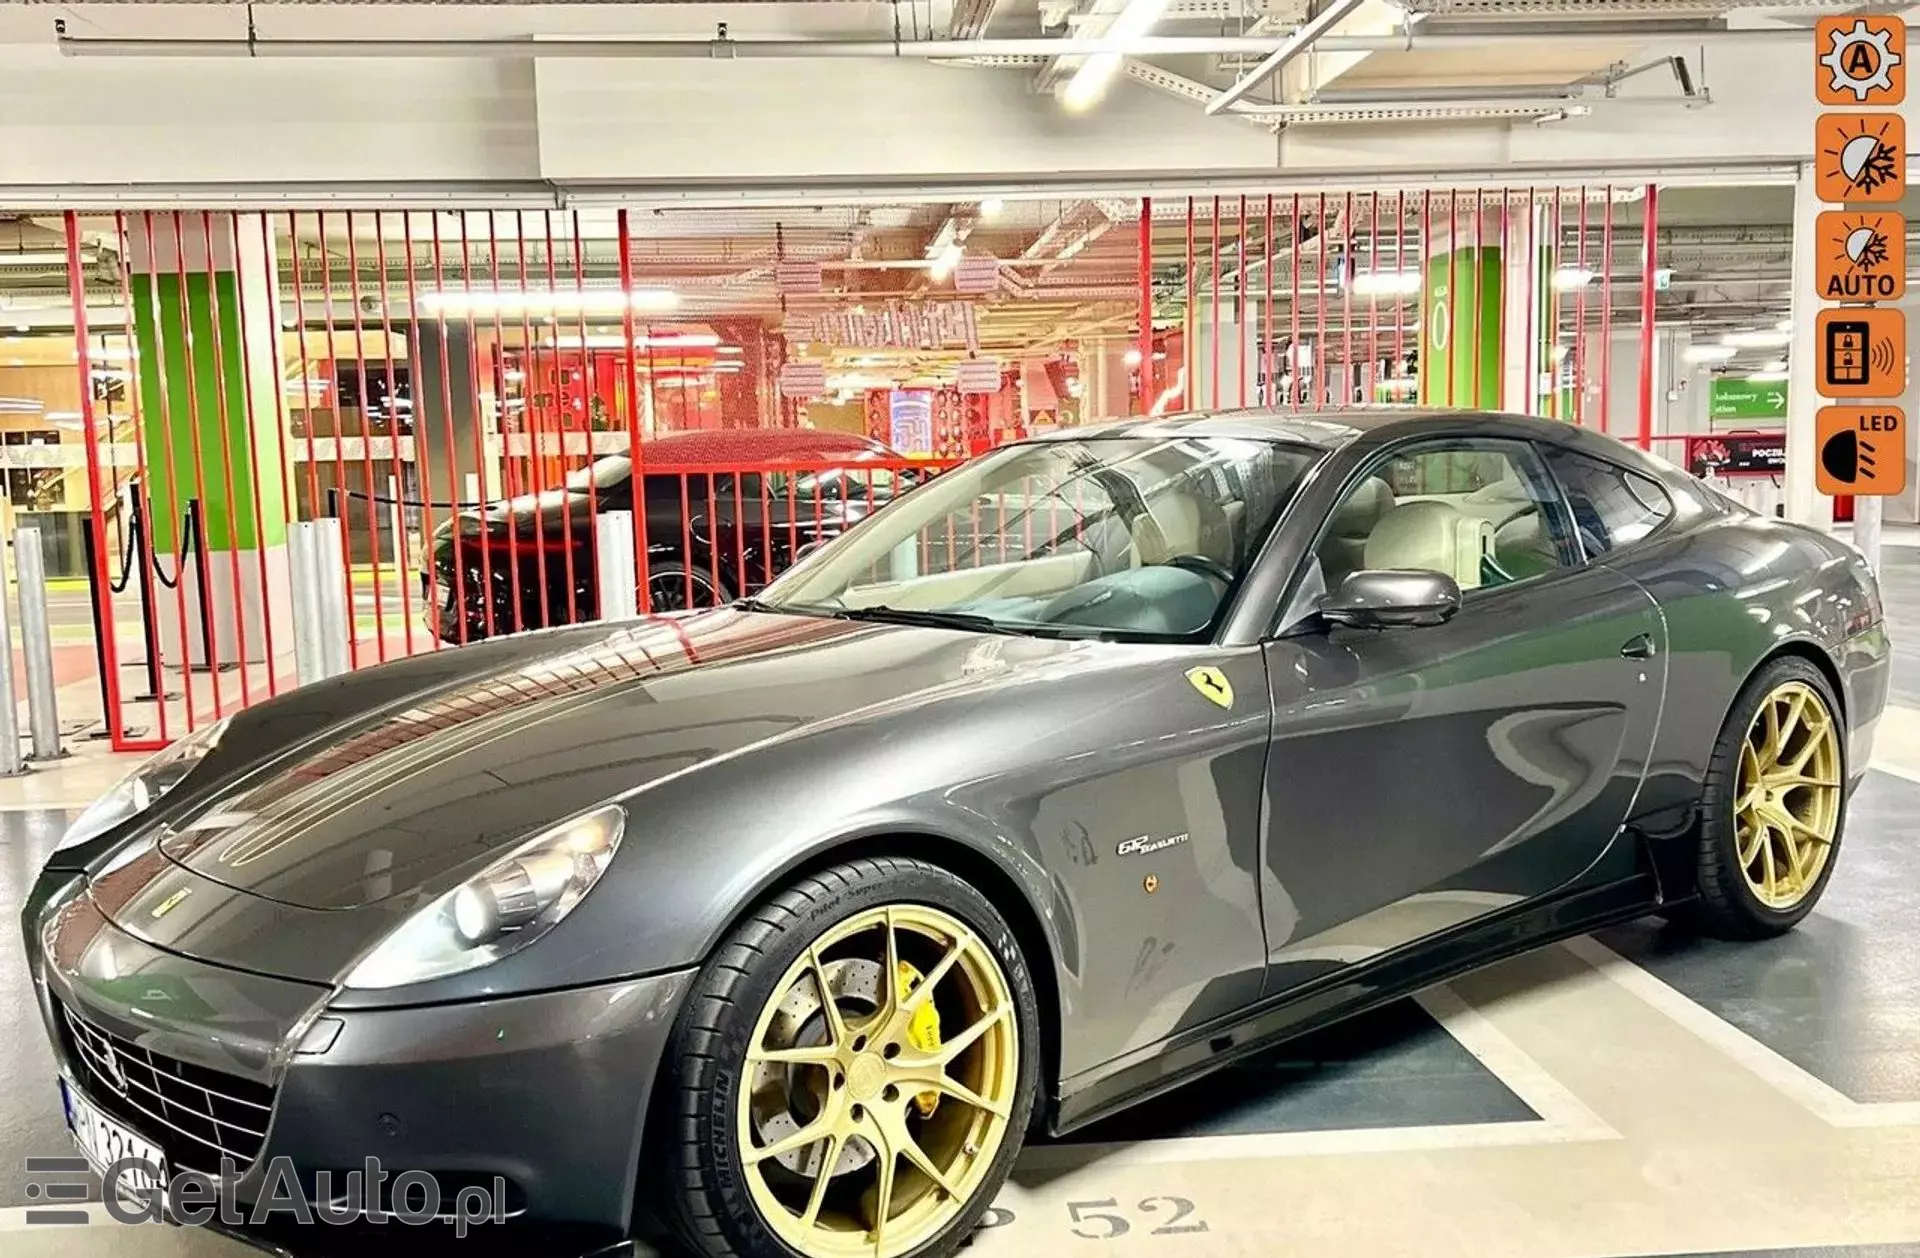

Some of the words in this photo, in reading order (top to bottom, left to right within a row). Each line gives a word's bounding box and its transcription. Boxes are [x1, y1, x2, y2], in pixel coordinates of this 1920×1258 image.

[808, 895, 841, 922] Pilot
[711, 1068, 734, 1189] MICHELIN
[1066, 1196, 1210, 1240] 52
